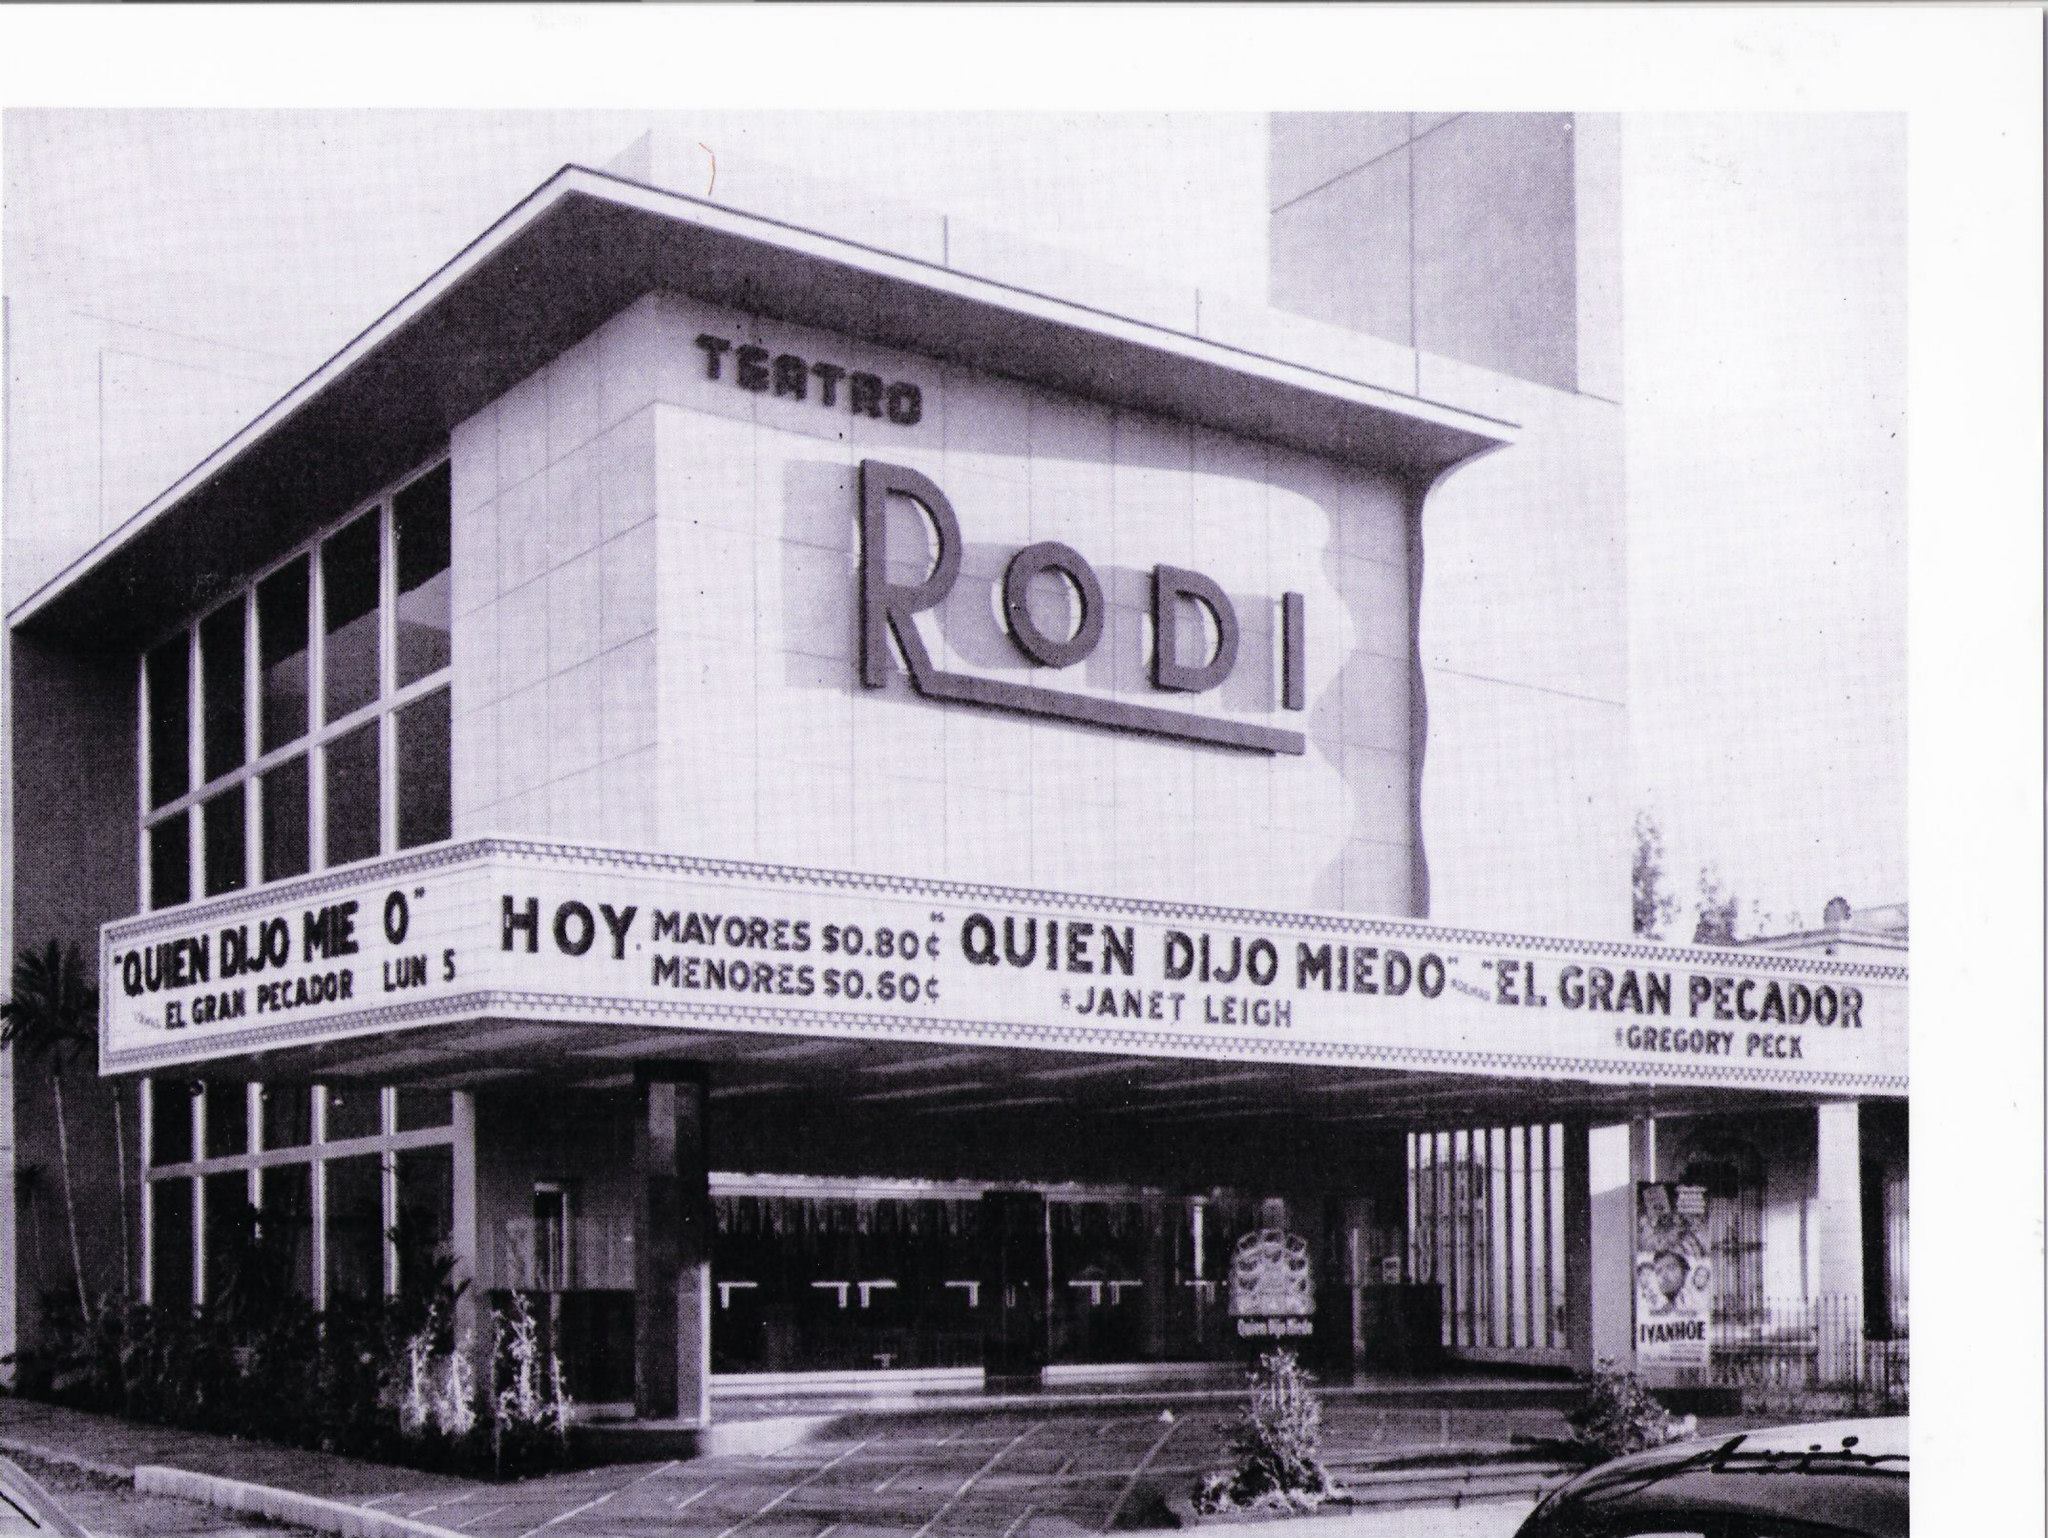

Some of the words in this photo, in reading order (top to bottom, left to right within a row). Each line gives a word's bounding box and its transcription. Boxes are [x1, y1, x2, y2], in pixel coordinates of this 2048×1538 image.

[696, 333, 923, 426] TEATRO
[859, 457, 1305, 756] RODI
[219, 917, 290, 980] DIJO
[303, 900, 359, 963] MIE
[651, 908, 812, 952] MAYORES
[383, 953, 427, 993] LUN
[650, 954, 815, 996] MENORES
[1163, 929, 1279, 987] DIJO
[165, 1000, 186, 1030] EL
[191, 989, 246, 1026] GRAN
[257, 968, 353, 1014] PECADOR
[1076, 987, 1182, 1023] JANET
[1204, 994, 1292, 1028] LEIGH
[1558, 965, 1671, 1016] GRAN
[1688, 976, 1864, 1029] PECADOR
[1626, 1025, 1735, 1057] GREGORY
[1746, 1032, 1803, 1060] PECK
[1640, 1320, 1705, 1343] IVANHOE
